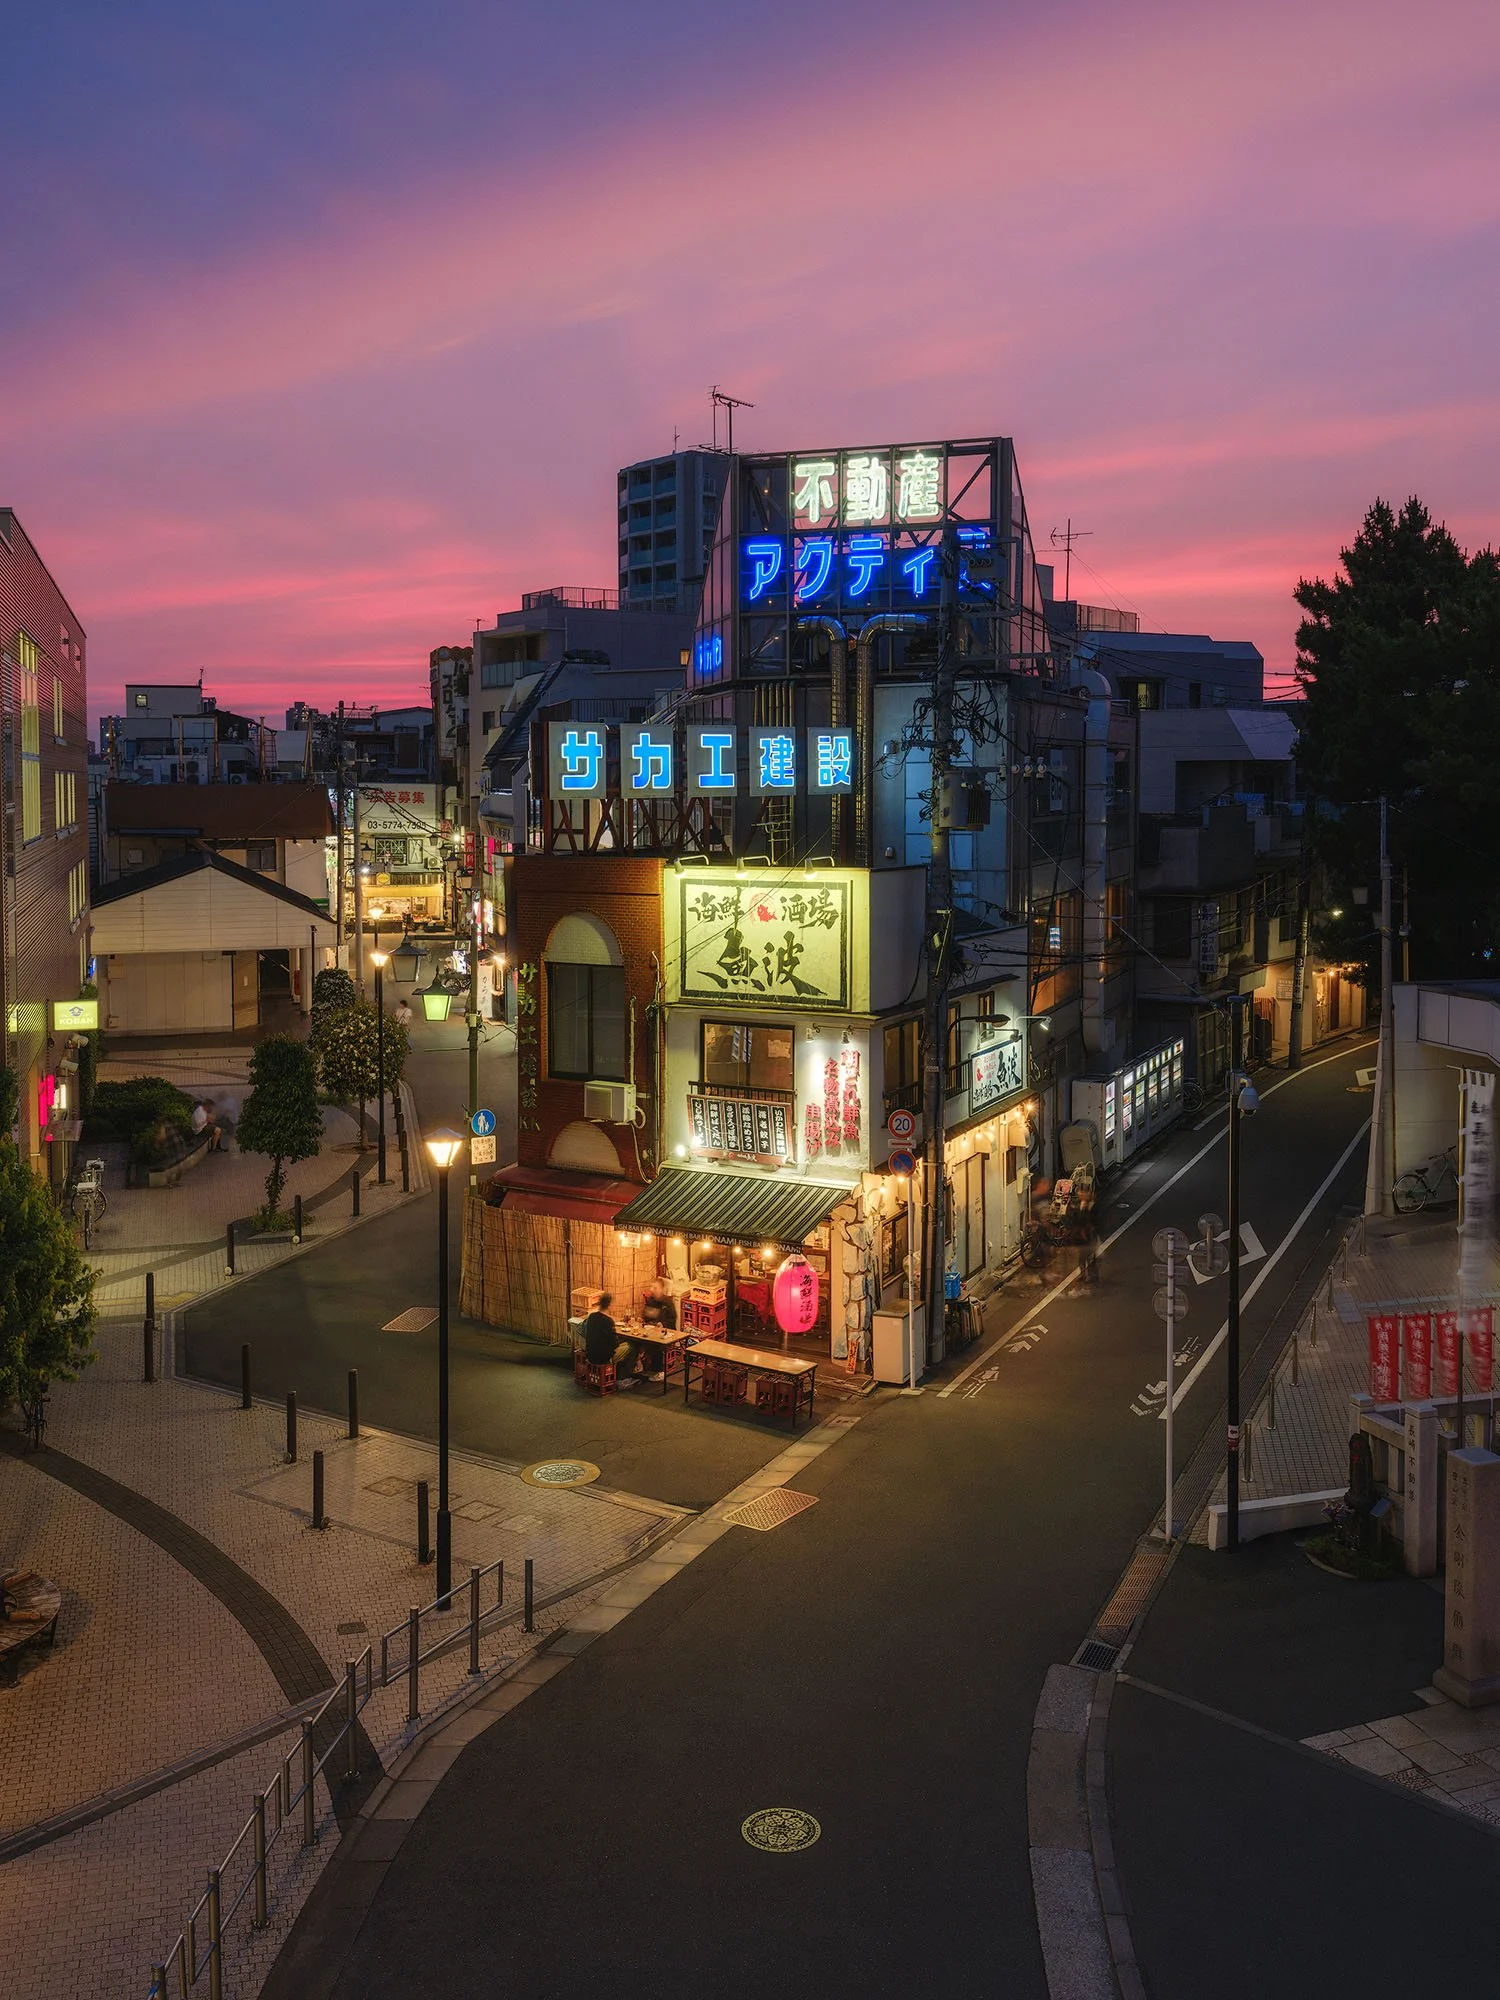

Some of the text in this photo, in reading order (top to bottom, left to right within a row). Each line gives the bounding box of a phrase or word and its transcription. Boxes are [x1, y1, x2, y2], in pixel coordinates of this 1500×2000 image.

[795, 453, 940, 523] 不動産
[561, 731, 851, 791] サカエ建設
[688, 887, 839, 930] 海鮮 酒場
[697, 928, 828, 996] 魚波
[59, 1016, 94, 1026] KOBAN
[804, 1103, 822, 1157] 串揚げ
[823, 1057, 841, 1149] 名物煮込み
[894, 1117, 911, 1131] 20
[701, 1232, 738, 1245] UONAMI
